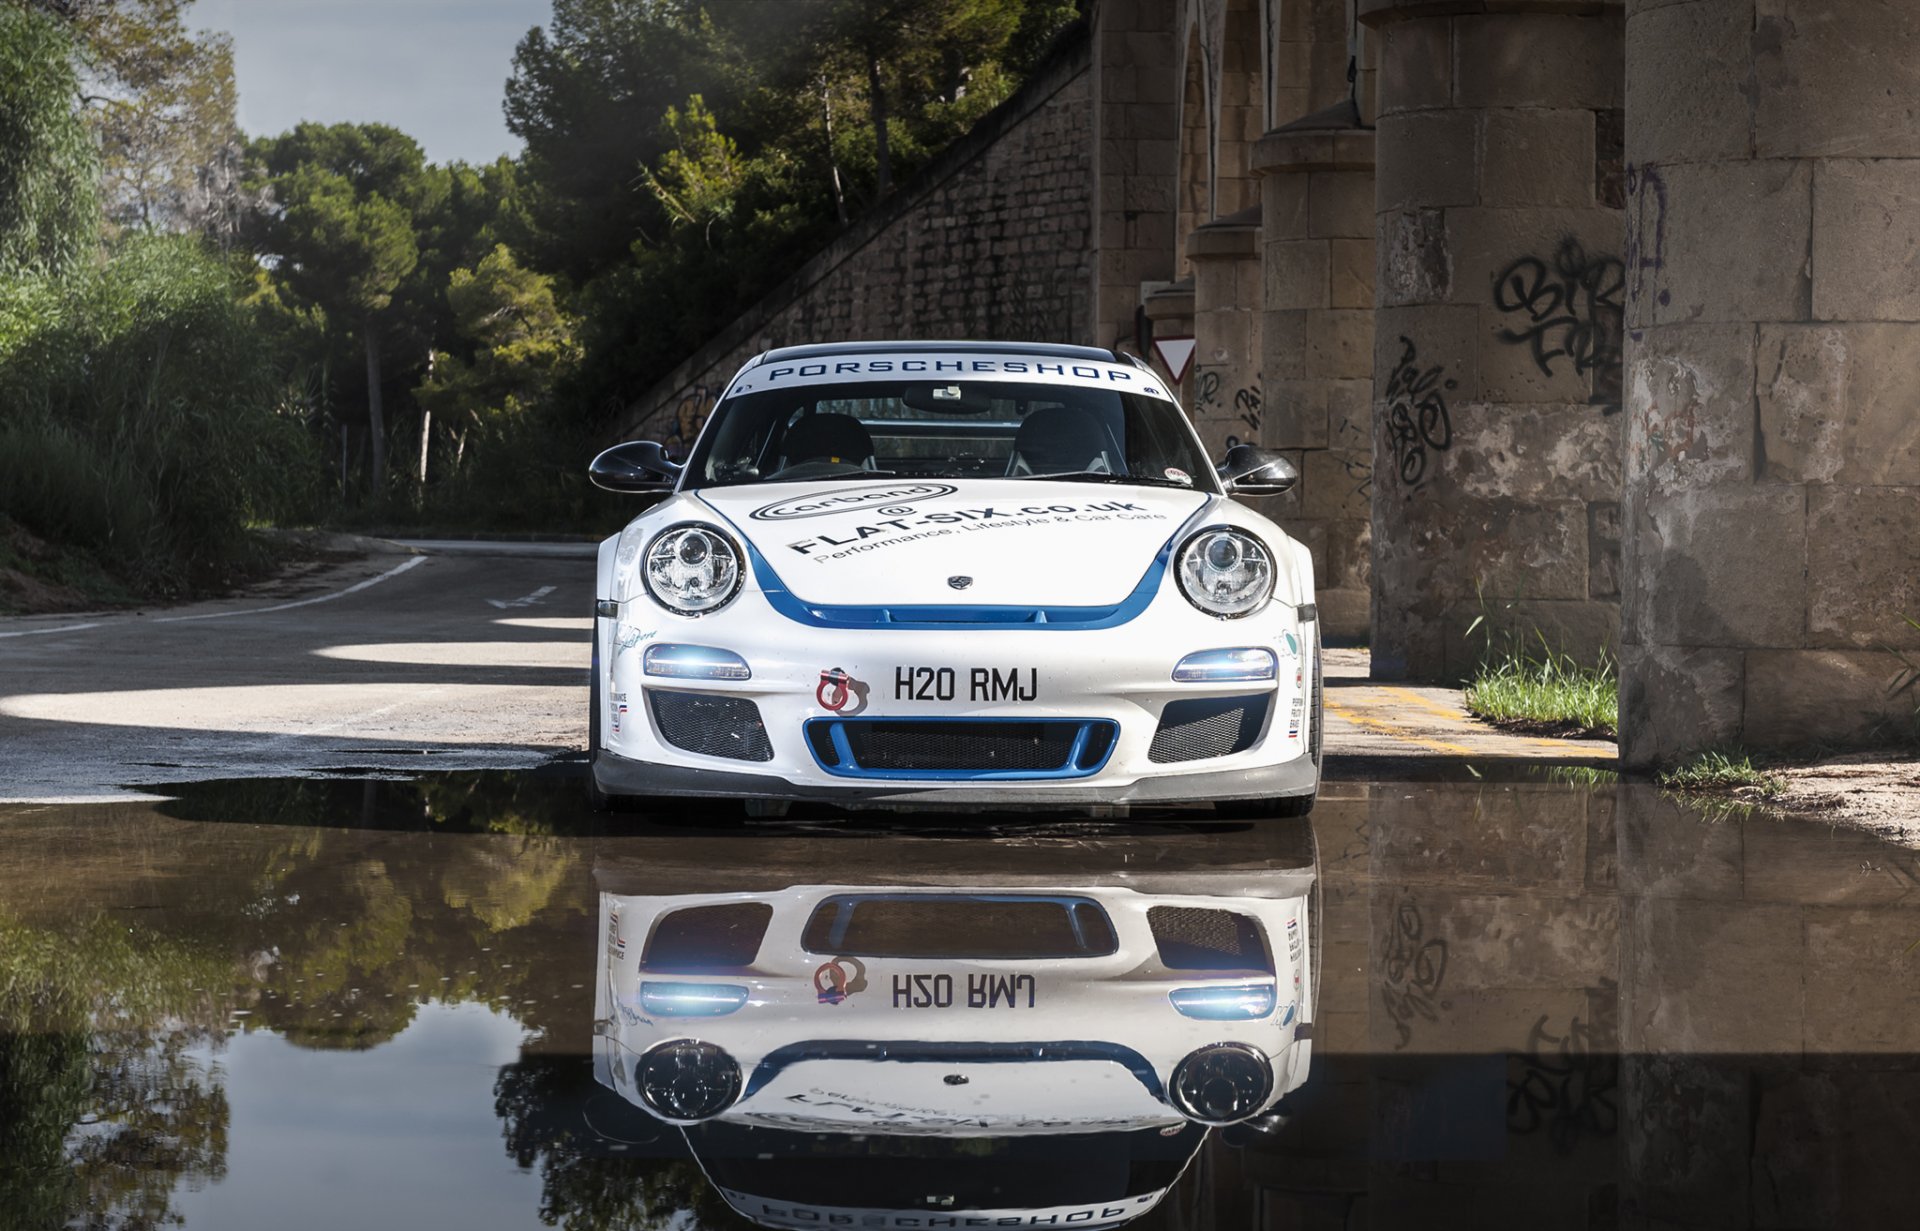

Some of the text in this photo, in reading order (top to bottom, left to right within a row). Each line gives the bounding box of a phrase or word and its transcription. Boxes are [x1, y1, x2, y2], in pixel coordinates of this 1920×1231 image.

[768, 360, 1132, 382] PORSCHESHOP
[876, 505, 918, 517] @
[785, 501, 1148, 555] FLAT-SIX.co.uk
[961, 517, 1050, 532] Lifestyle
[1053, 514, 1072, 522] &
[970, 667, 1038, 701] RMJ
